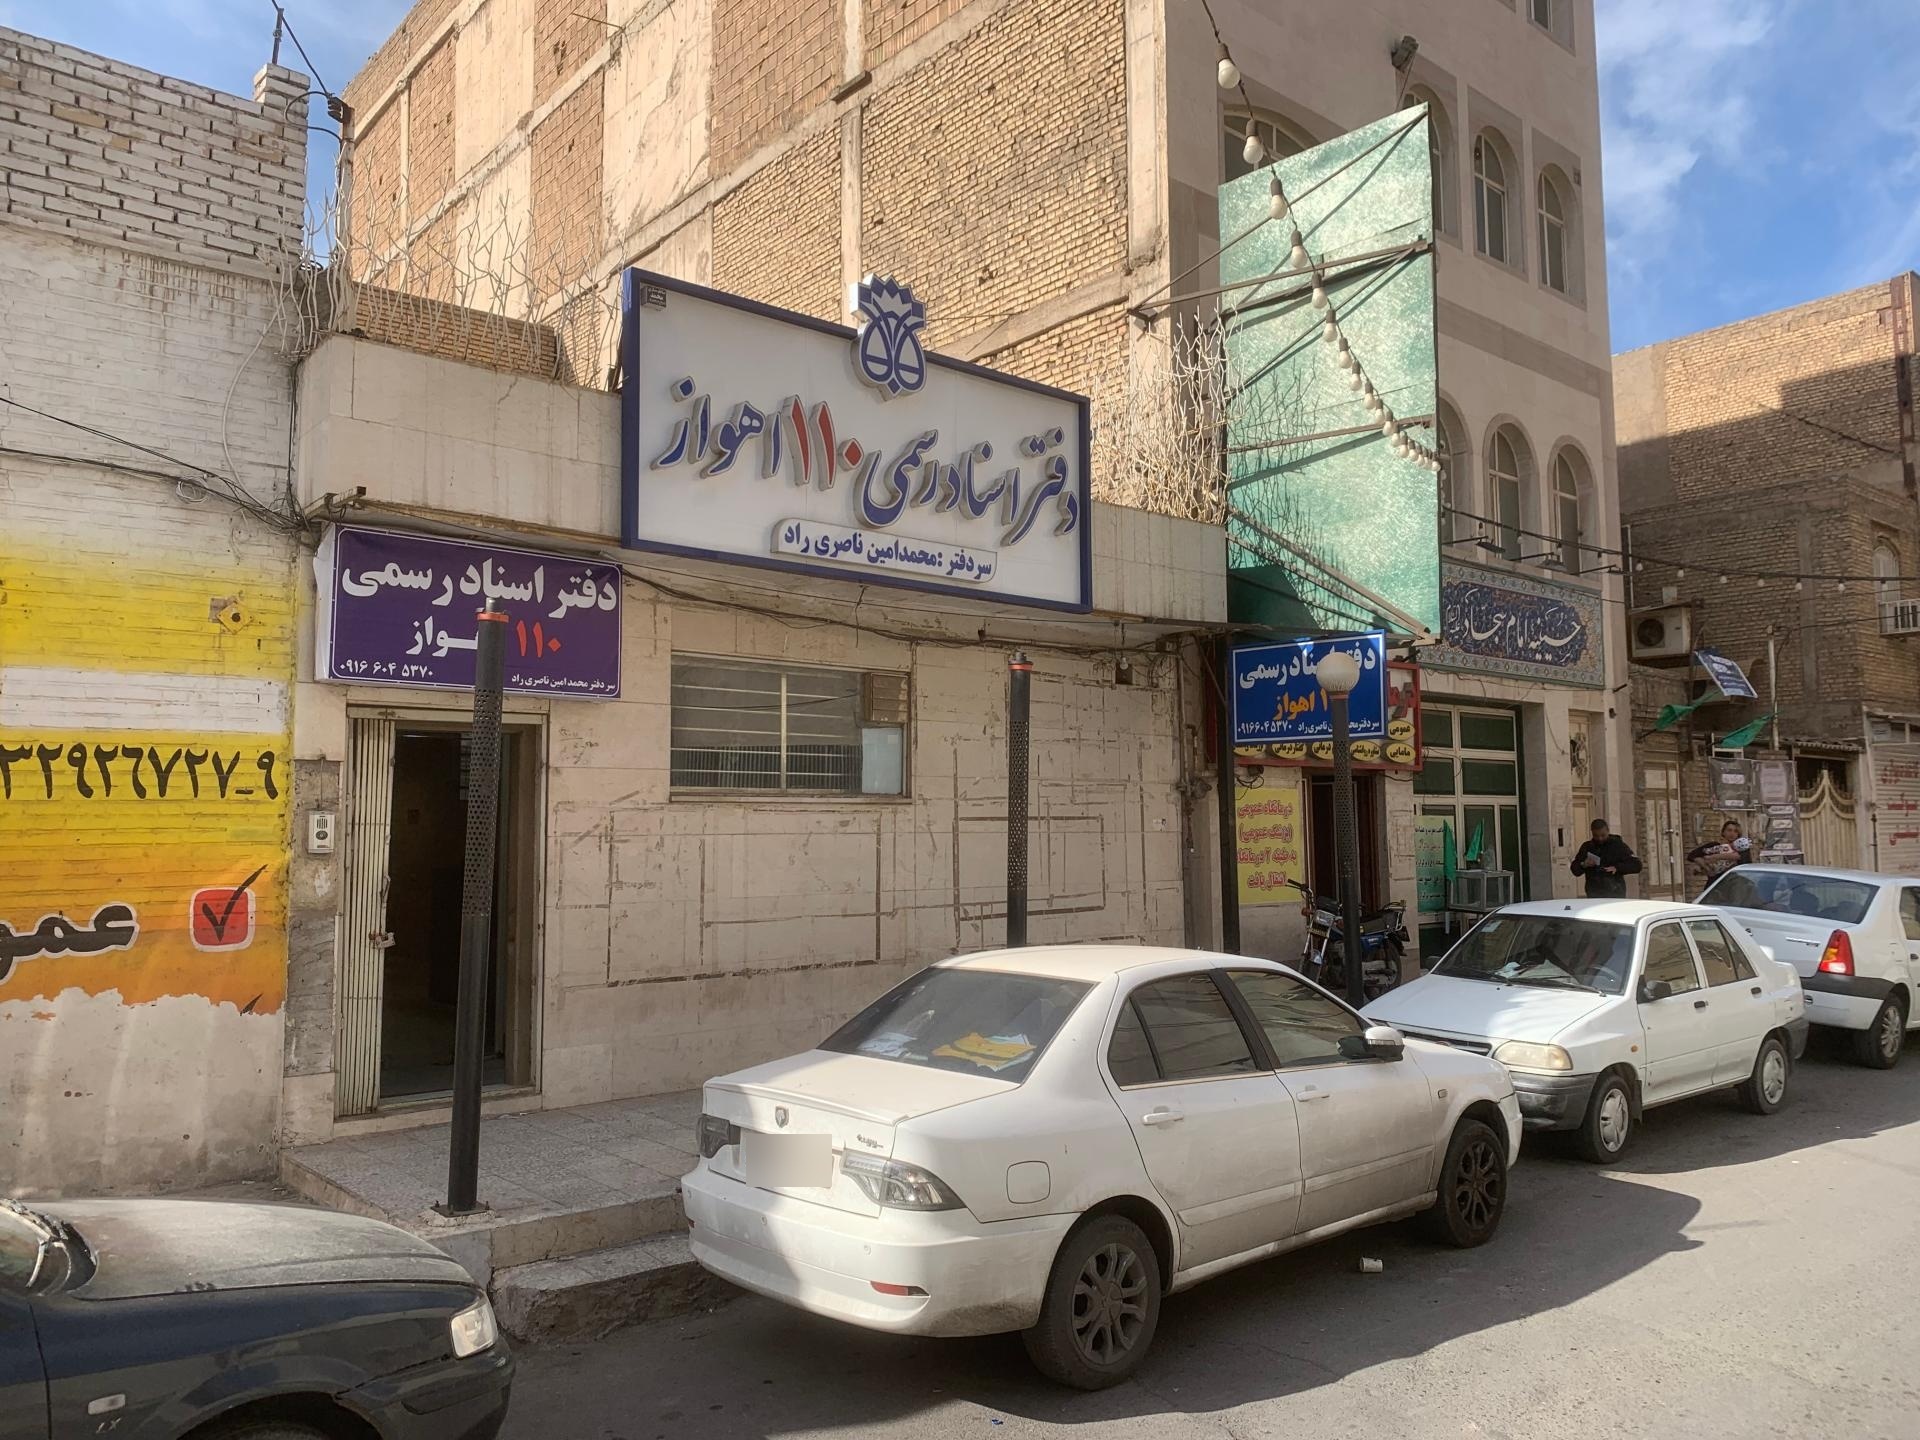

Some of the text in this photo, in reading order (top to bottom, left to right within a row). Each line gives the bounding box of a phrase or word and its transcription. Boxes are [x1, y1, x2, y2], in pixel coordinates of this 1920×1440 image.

[651, 375, 1078, 546] دفتر اسناد رسمی ۱۱۰ اهواز
[784, 525, 810, 553] راد
[814, 532, 864, 558] ناصری
[341, 558, 617, 619] دفتر اسناد رسمی
[405, 615, 562, 658] ۱۱۰ واز
[340, 659, 433, 678] ۰۹۱۶ ۶۰۴ ۵۳۷۰
[1239, 663, 1288, 689] رسمی
[511, 673, 524, 686] راد
[524, 675, 550, 687] ناصری
[549, 677, 567, 688] امین
[567, 679, 588, 688] محمد
[1272, 690, 1315, 721] اهواز
[1308, 720, 1328, 734] ناصری
[1389, 724, 1411, 736] عمومی
[1389, 745, 1411, 758] مامایی
